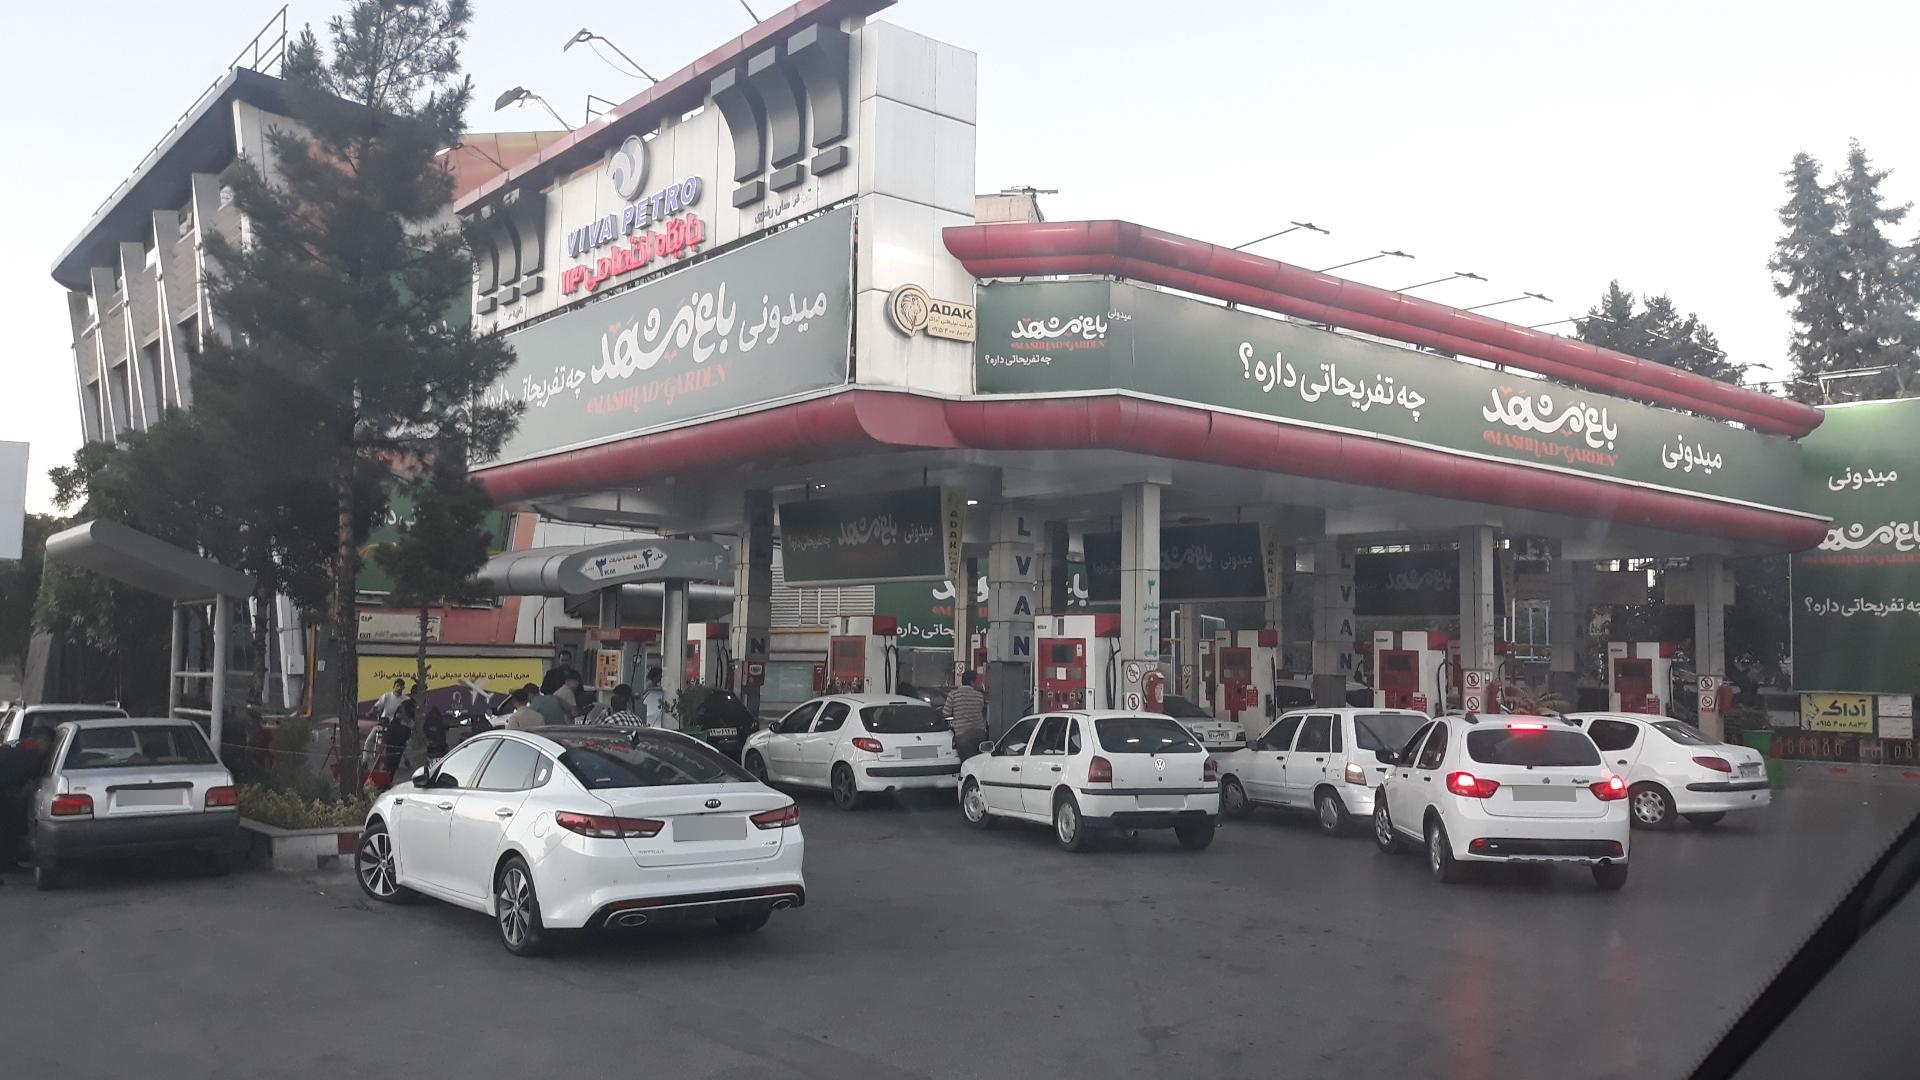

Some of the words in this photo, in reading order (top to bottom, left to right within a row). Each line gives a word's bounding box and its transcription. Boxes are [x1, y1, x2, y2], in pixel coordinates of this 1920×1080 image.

[568, 214, 615, 257] VIVA
[622, 176, 701, 235] PETRO
[692, 282, 737, 363] باغ
[739, 292, 827, 352] میدونی
[930, 303, 973, 320] ADAK
[1108, 308, 1132, 320] میدونی
[1011, 317, 1082, 339] مشهد
[1081, 315, 1108, 339] باغ
[591, 305, 695, 384] مشهد
[985, 354, 1004, 366] داره؟
[1005, 354, 1040, 366] تفریحاتی
[1041, 356, 1052, 366] چه
[1239, 342, 1297, 392] داره؟
[566, 367, 586, 399] چه
[1300, 363, 1395, 412] تفریحاتی
[1397, 385, 1426, 421] چه
[1483, 388, 1585, 433] مشهد
[1580, 402, 1618, 451] باغ
[1662, 434, 1722, 475] میدونی
[1828, 467, 1897, 491] میدونی
[604, 568, 616, 576] KM
[1804, 596, 1839, 616] داره؟
[1841, 597, 1905, 617] تفریحاتی
[440, 671, 462, 680] محیطی
[463, 671, 486, 679] تبلیغات
[487, 671, 513, 680] انحصاری
[1822, 698, 1867, 717] آداک
[707, 799, 720, 808] KIA
